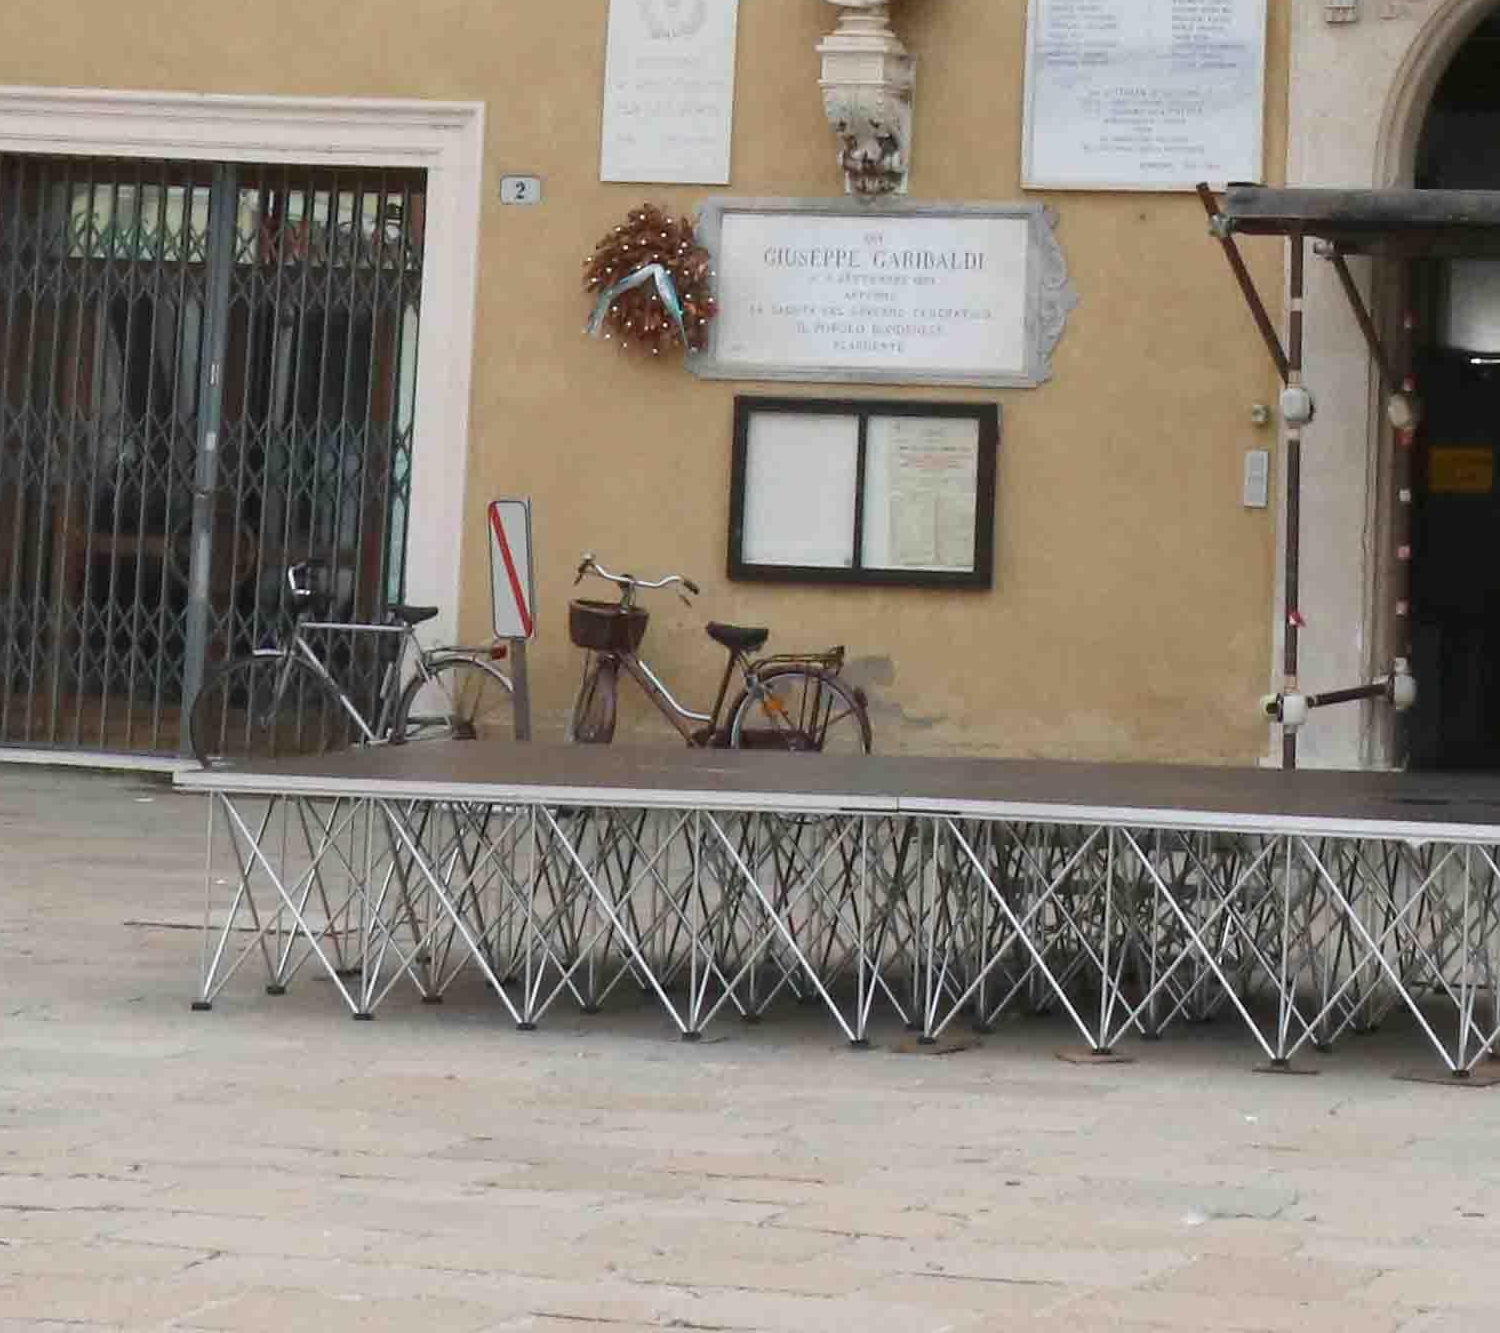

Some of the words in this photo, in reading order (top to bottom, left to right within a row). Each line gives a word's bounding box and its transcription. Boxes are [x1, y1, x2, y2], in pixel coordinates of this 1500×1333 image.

[515, 180, 525, 200] 2
[763, 248, 861, 269] GIUSEPPE
[872, 250, 987, 271] GARIBALDI
